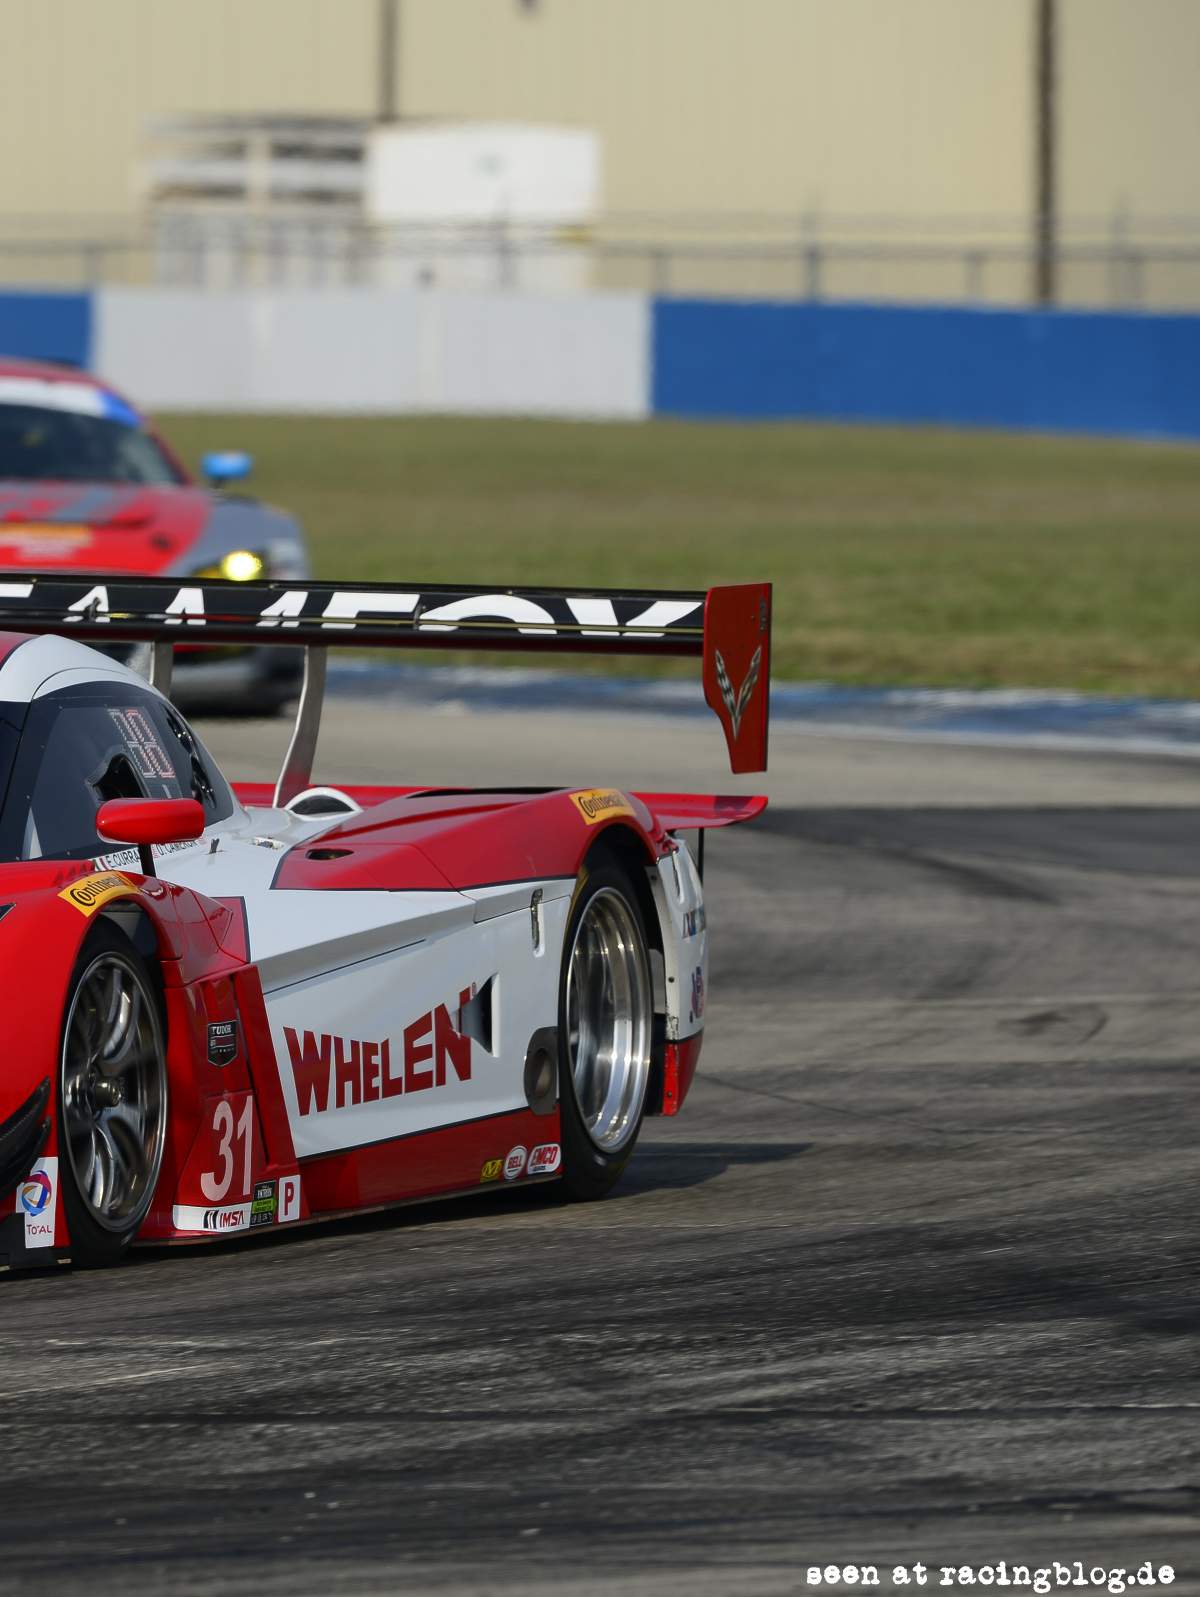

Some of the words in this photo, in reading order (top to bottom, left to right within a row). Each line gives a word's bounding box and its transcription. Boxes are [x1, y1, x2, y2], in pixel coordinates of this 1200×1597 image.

[283, 986, 473, 1117] WHELEN
[200, 1095, 253, 1202] 31
[284, 1181, 295, 1216] P
[26, 1224, 53, 1236] TOTAL
[219, 1210, 245, 1228] IMSA
